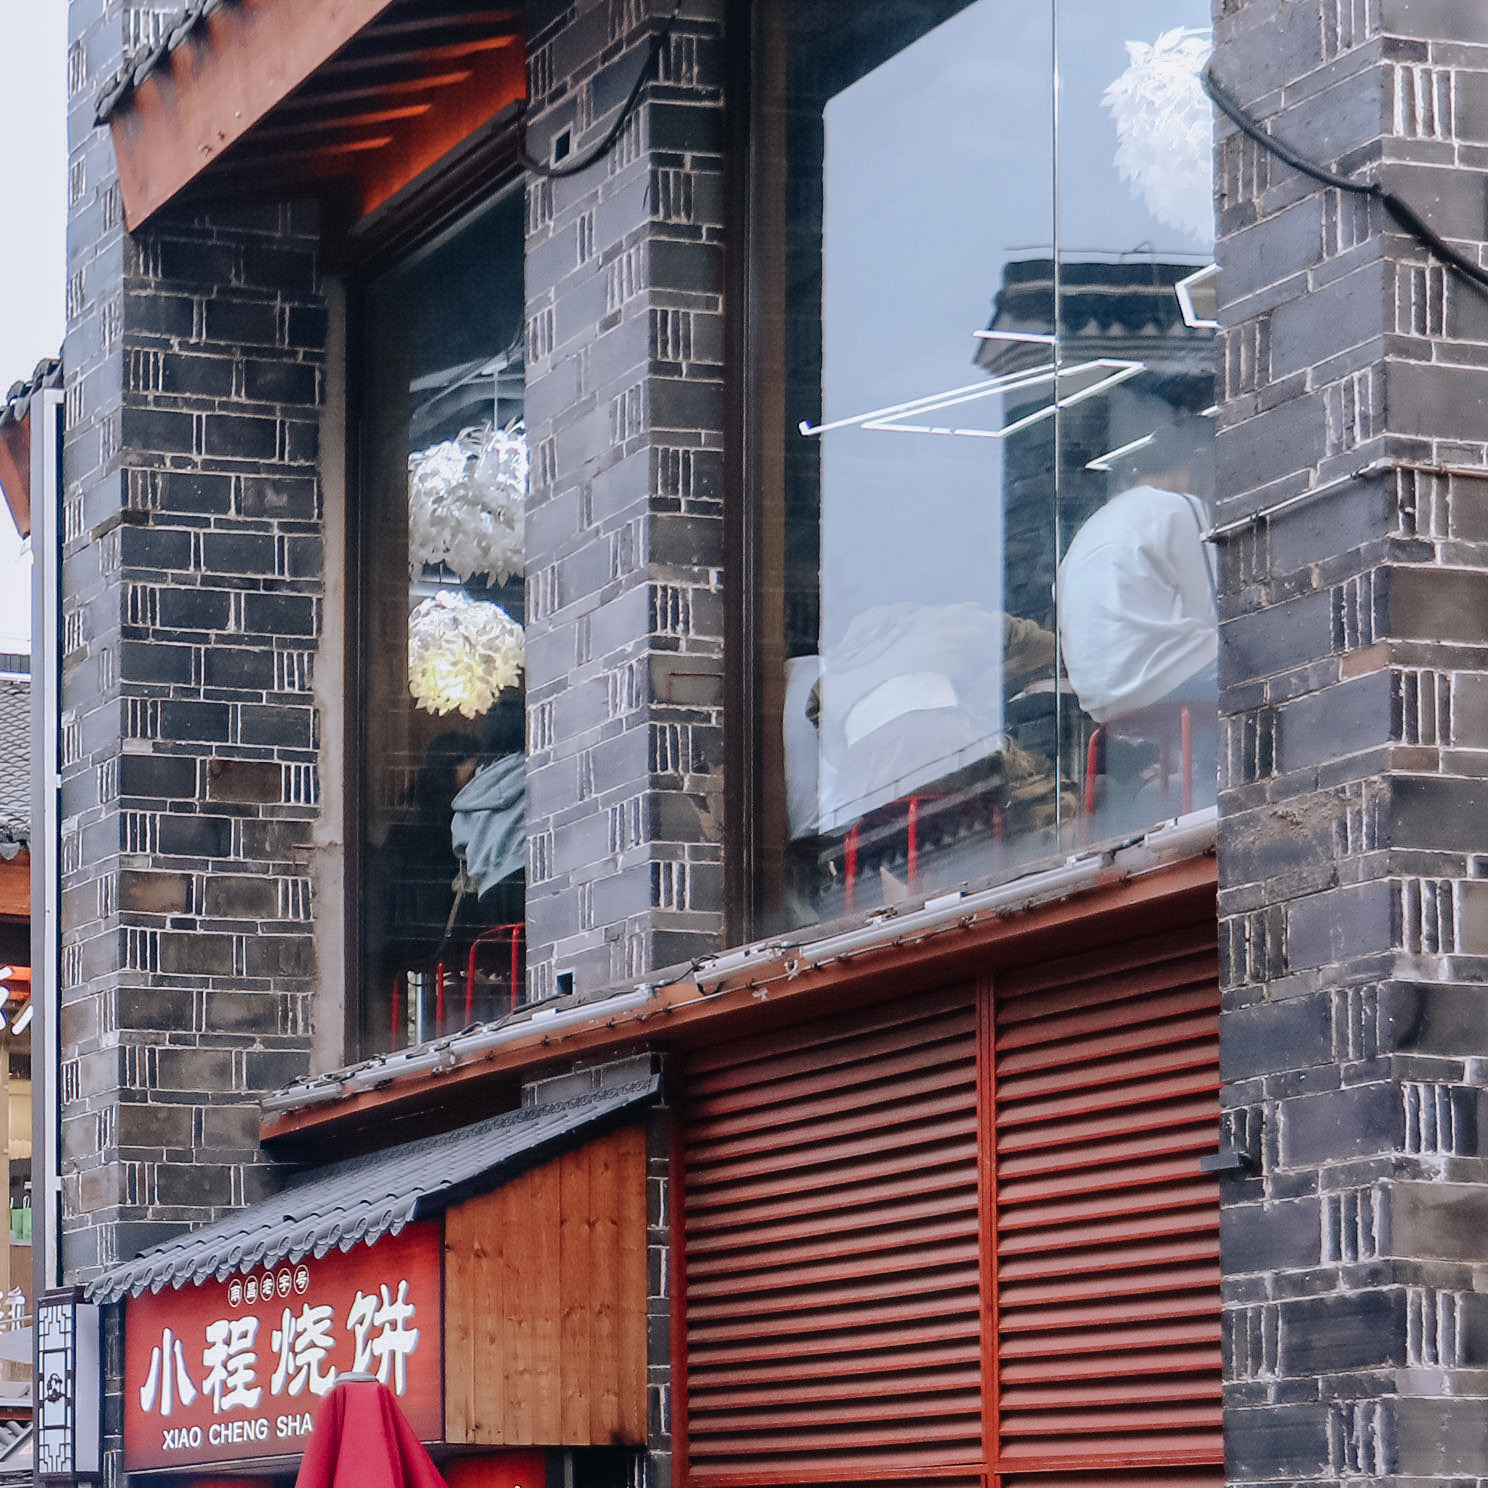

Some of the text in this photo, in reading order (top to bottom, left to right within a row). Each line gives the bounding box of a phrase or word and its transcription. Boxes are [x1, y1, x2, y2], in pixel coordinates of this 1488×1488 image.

[228, 1267, 309, 1305] 南昌老字号
[140, 1279, 421, 1417] 小程烧饼
[162, 1413, 314, 1450] XIAO CHENG SHA
